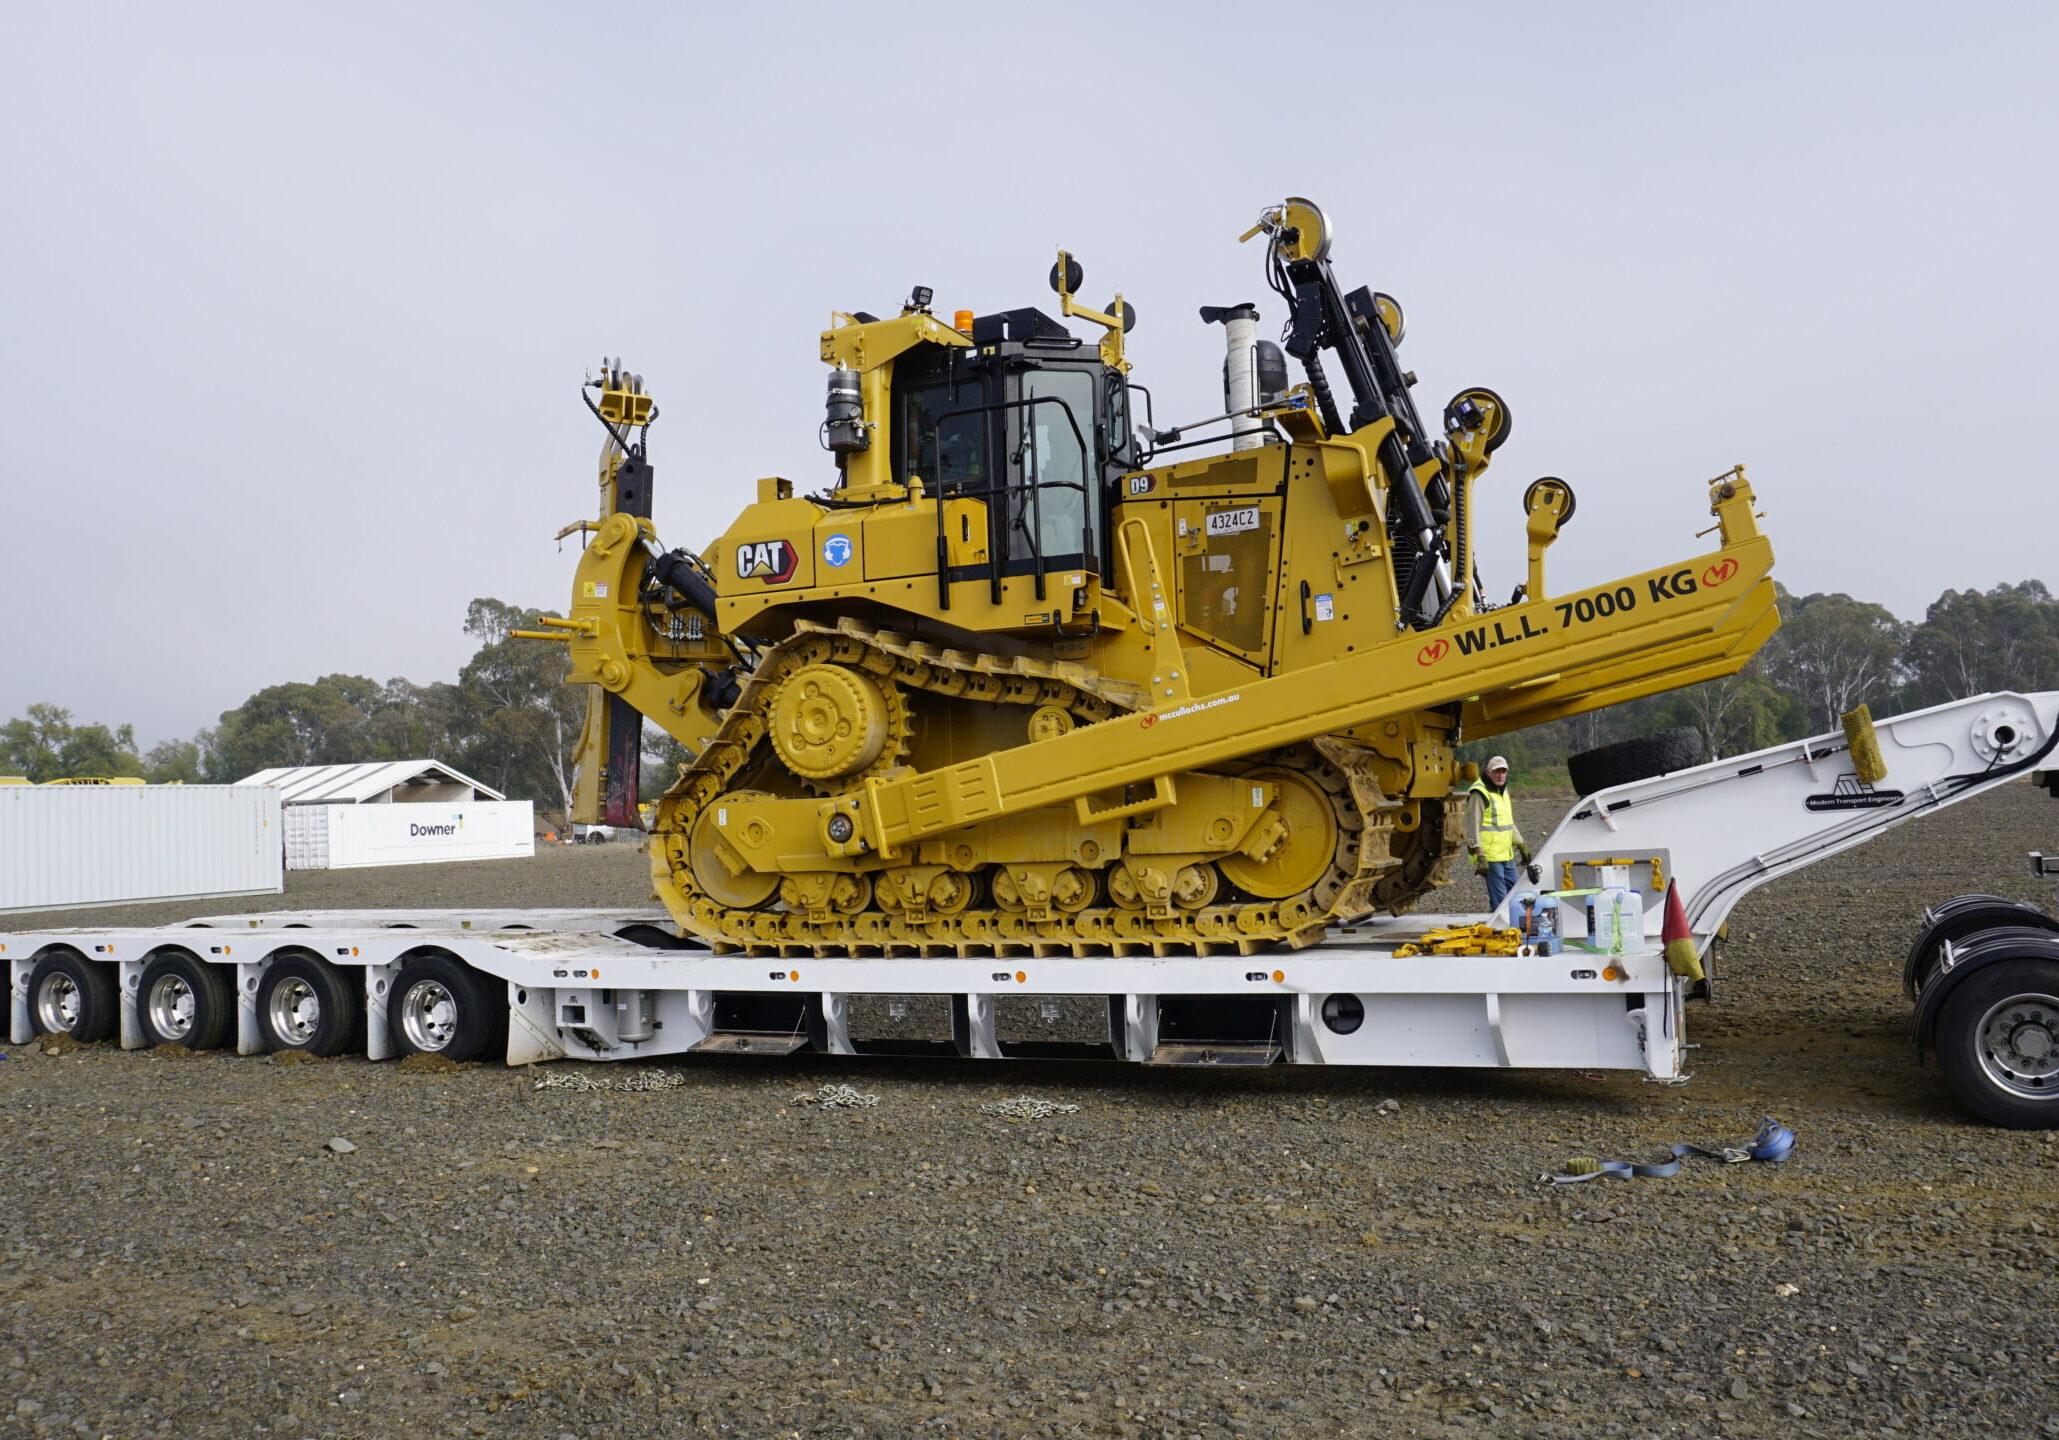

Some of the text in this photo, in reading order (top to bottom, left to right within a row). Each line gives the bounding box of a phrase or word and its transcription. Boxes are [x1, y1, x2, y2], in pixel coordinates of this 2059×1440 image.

[1130, 476, 1149, 495] D9
[737, 541, 782, 578] CAT
[1454, 615, 1549, 656] W.L.L.
[1554, 586, 1636, 628] 7000
[1648, 569, 1698, 603] KG
[1159, 693, 1240, 721] mccullochs.com.au
[1836, 797, 1867, 806] Transport
[1868, 795, 1902, 803] Engineers
[410, 823, 456, 837] Downer
